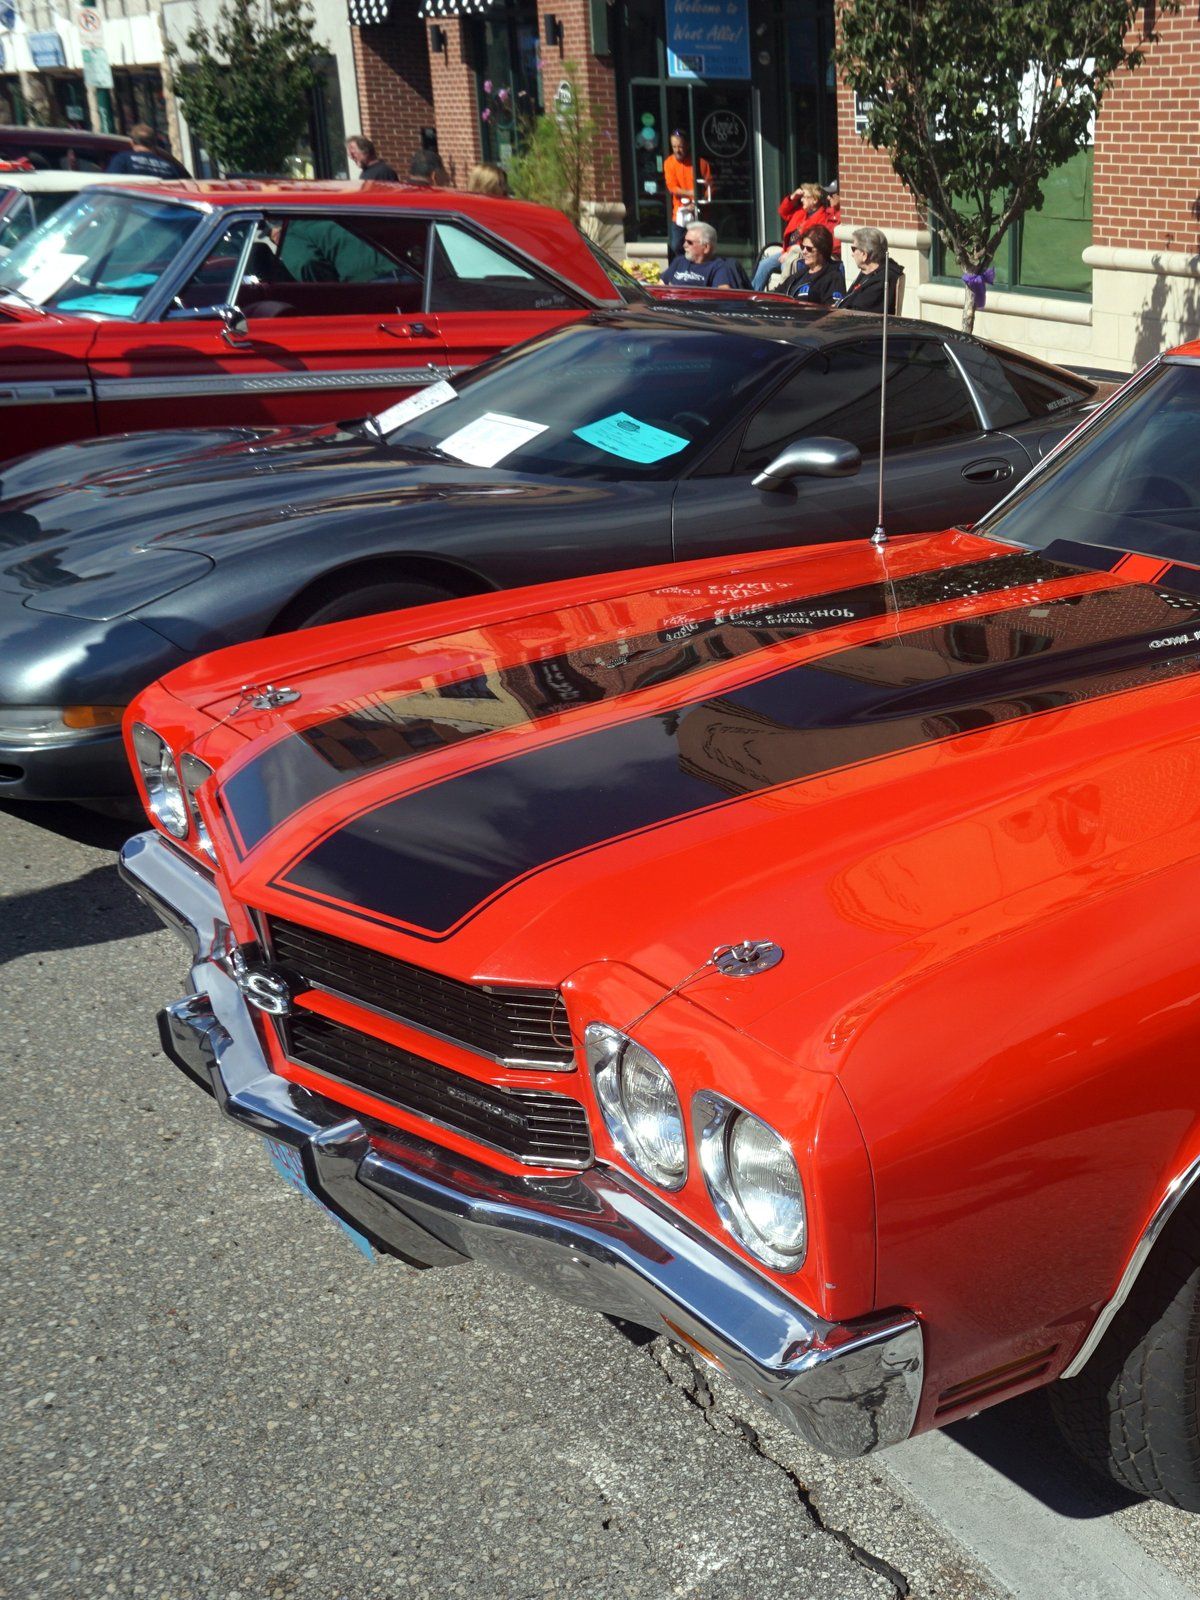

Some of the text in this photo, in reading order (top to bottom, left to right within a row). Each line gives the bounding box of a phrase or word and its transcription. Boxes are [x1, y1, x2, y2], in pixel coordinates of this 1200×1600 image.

[674, 0, 721, 14] Welcome
[673, 24, 703, 41] West
[1149, 634, 1192, 648] COWL
[446, 1084, 529, 1128] CHEVROLET
